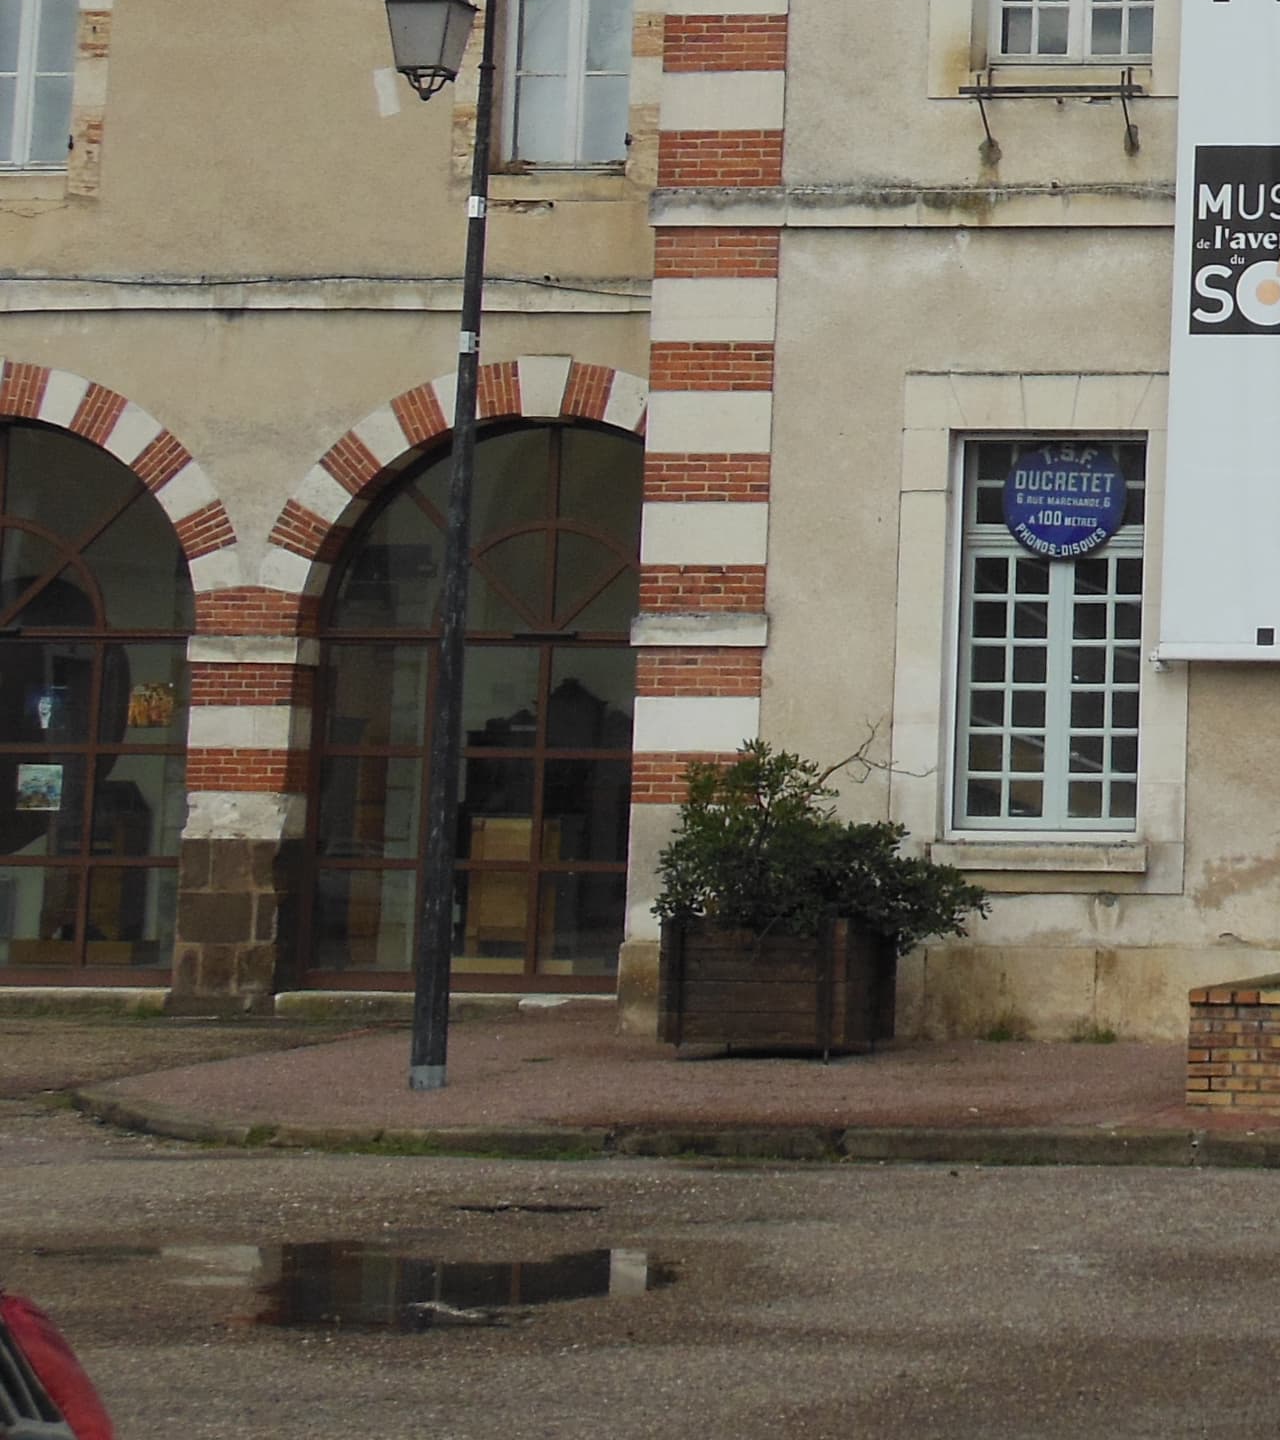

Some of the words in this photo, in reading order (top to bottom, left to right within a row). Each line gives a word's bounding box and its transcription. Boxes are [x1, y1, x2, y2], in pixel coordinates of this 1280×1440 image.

[1196, 238, 1211, 250] de
[1230, 254, 1245, 265] du
[1015, 470, 1116, 493] DUCRETET
[1038, 509, 1062, 526] 100
